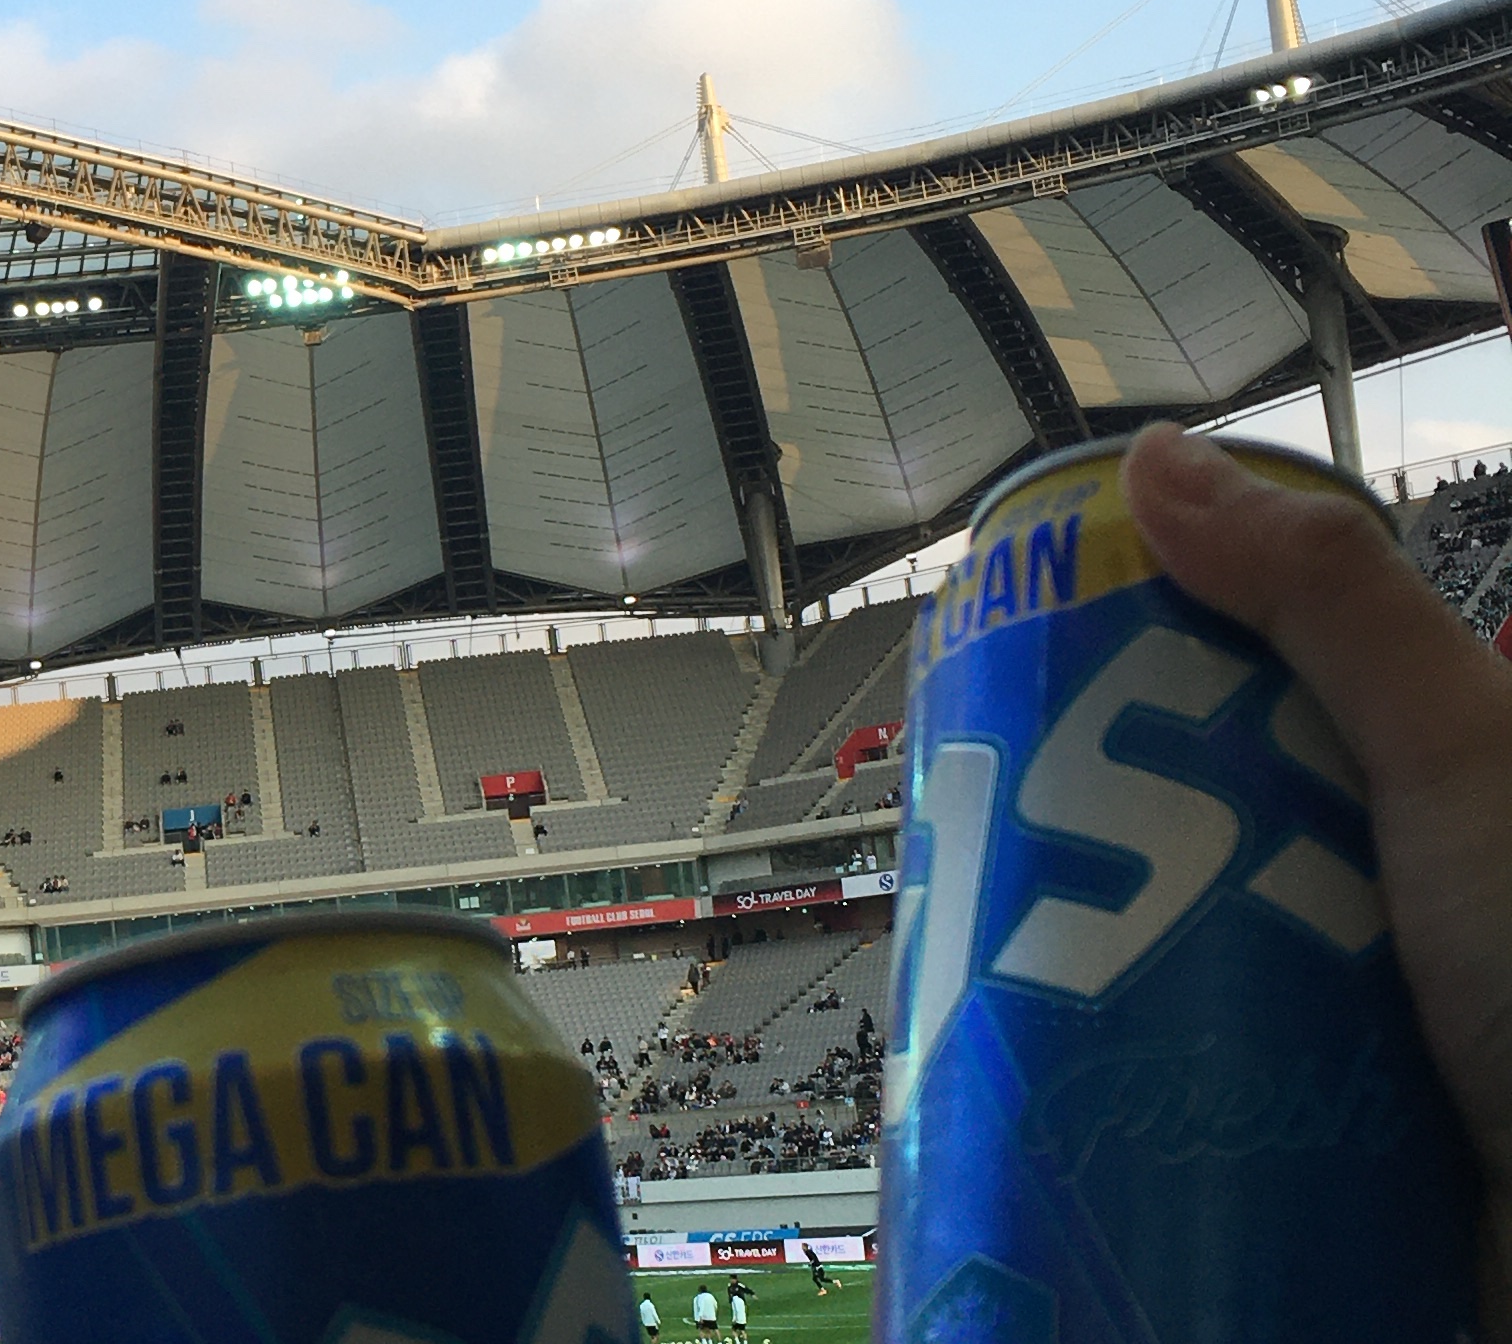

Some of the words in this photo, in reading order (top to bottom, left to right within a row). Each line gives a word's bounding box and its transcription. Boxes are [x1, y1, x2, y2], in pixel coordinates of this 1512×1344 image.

[506, 776, 516, 789] P
[736, 893, 759, 910] SOL
[759, 890, 794, 905] TRAVEL
[795, 886, 817, 900] DAY
[566, 913, 605, 926] FOOTBALL
[606, 910, 628, 923] CLUB
[19, 1048, 284, 1243] MEGA
[296, 1034, 515, 1180] CAN
[718, 1247, 734, 1260] SOL
[734, 1248, 761, 1258] TRAVEL
[761, 1247, 777, 1258] DAY
